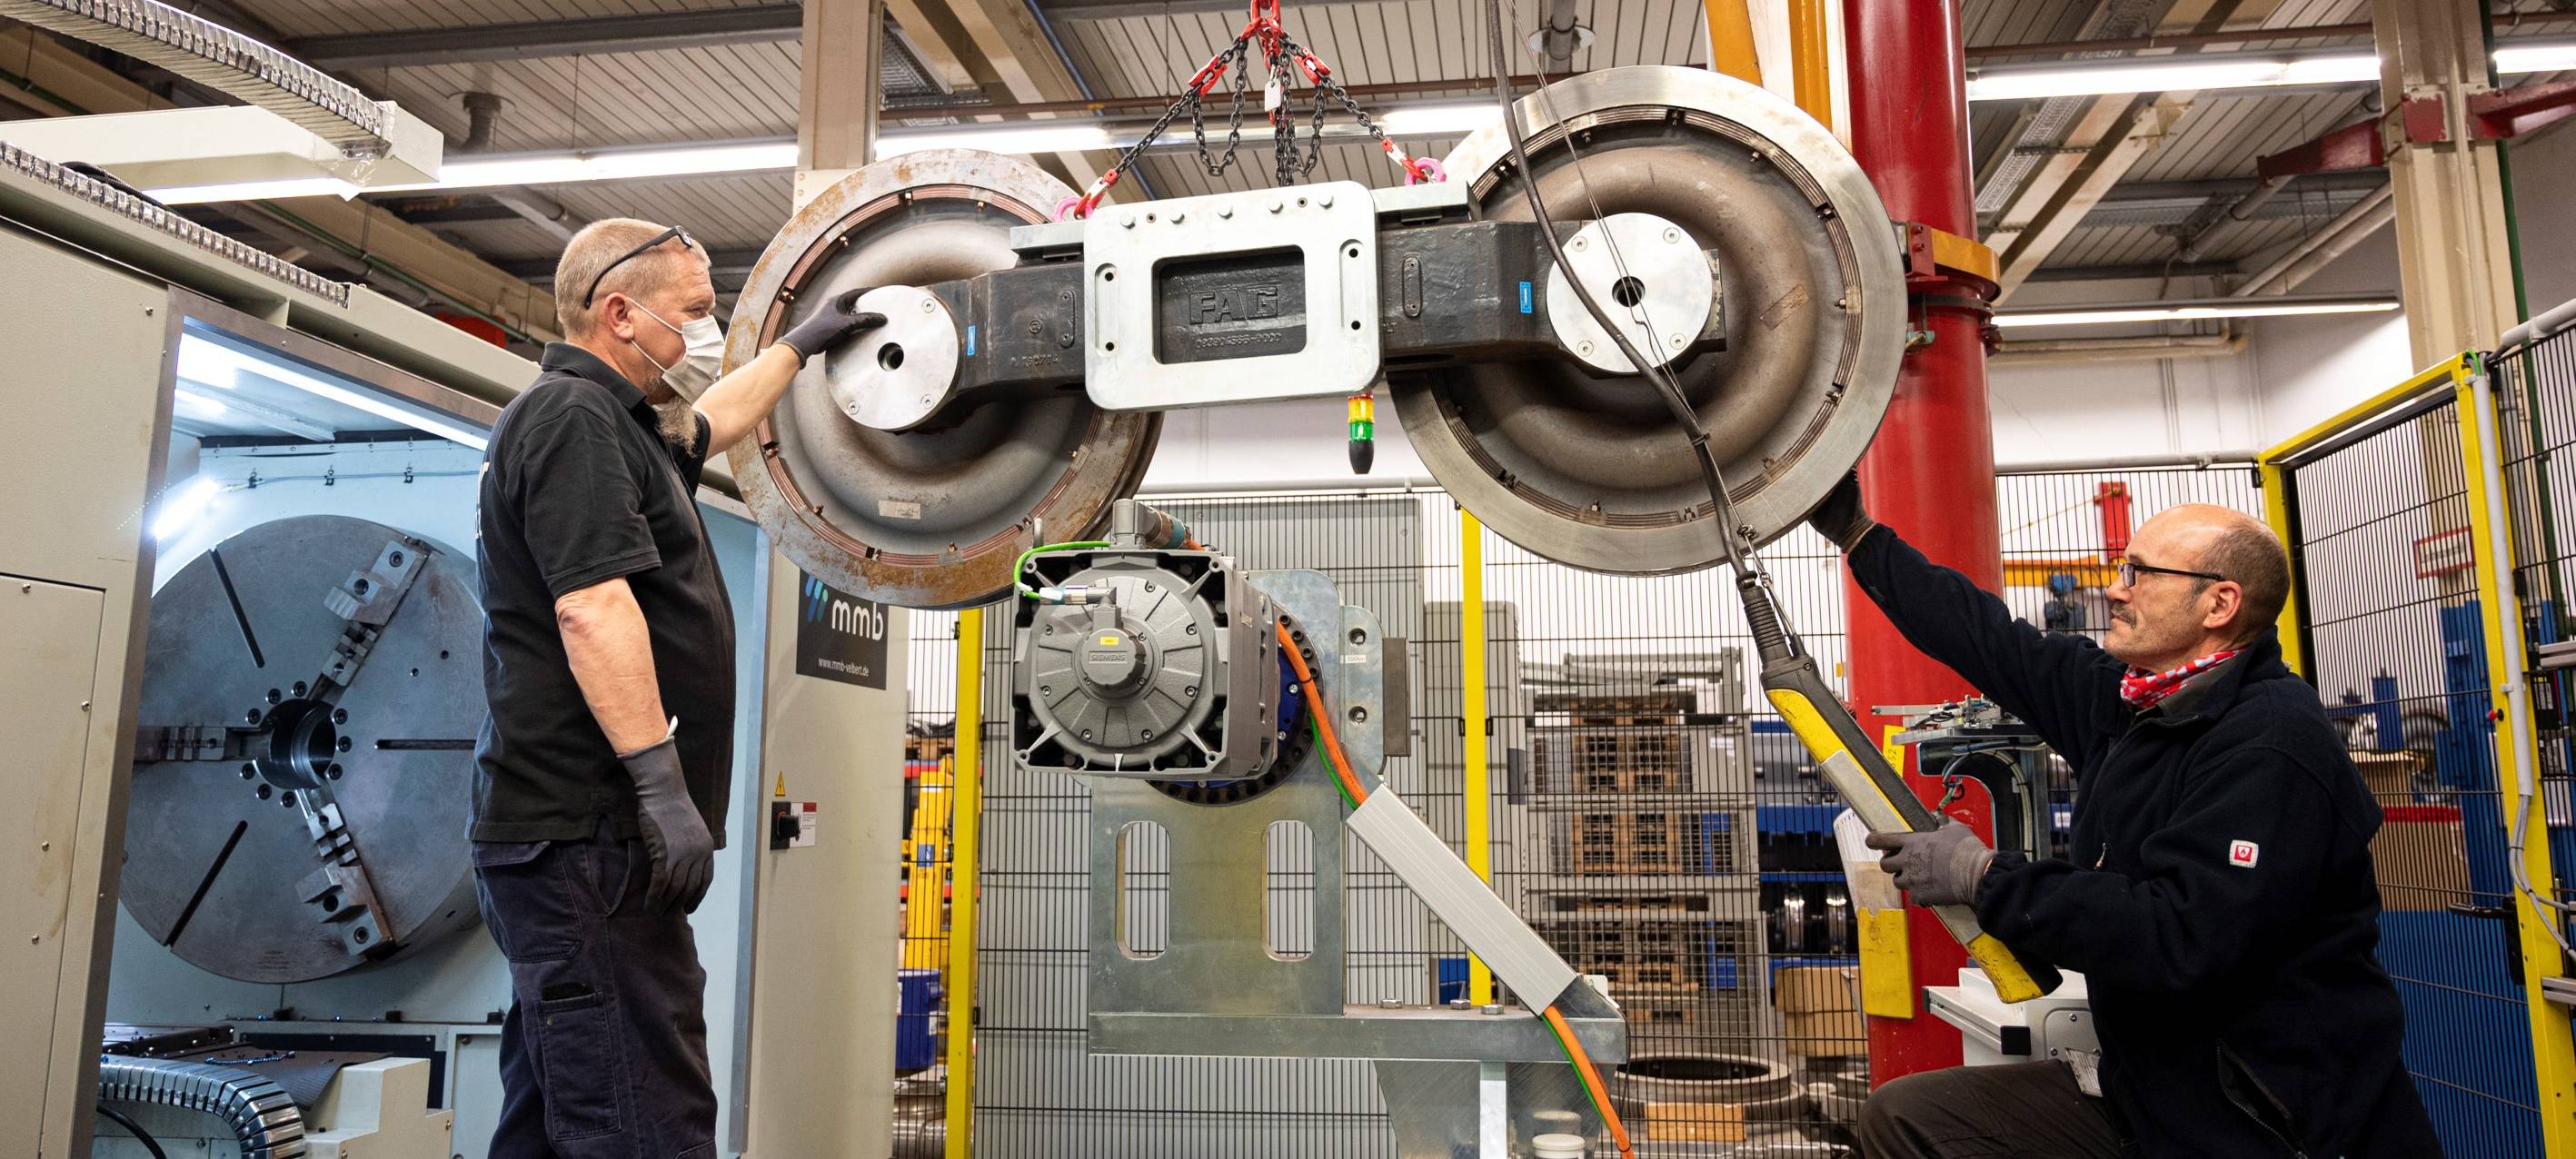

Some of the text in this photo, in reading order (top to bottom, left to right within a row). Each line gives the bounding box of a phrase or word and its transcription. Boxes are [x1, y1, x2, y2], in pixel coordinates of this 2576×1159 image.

[1189, 285, 1278, 325] FAG
[831, 599, 884, 640] mmb
[818, 658, 870, 677] www.mmb-velbert.de
